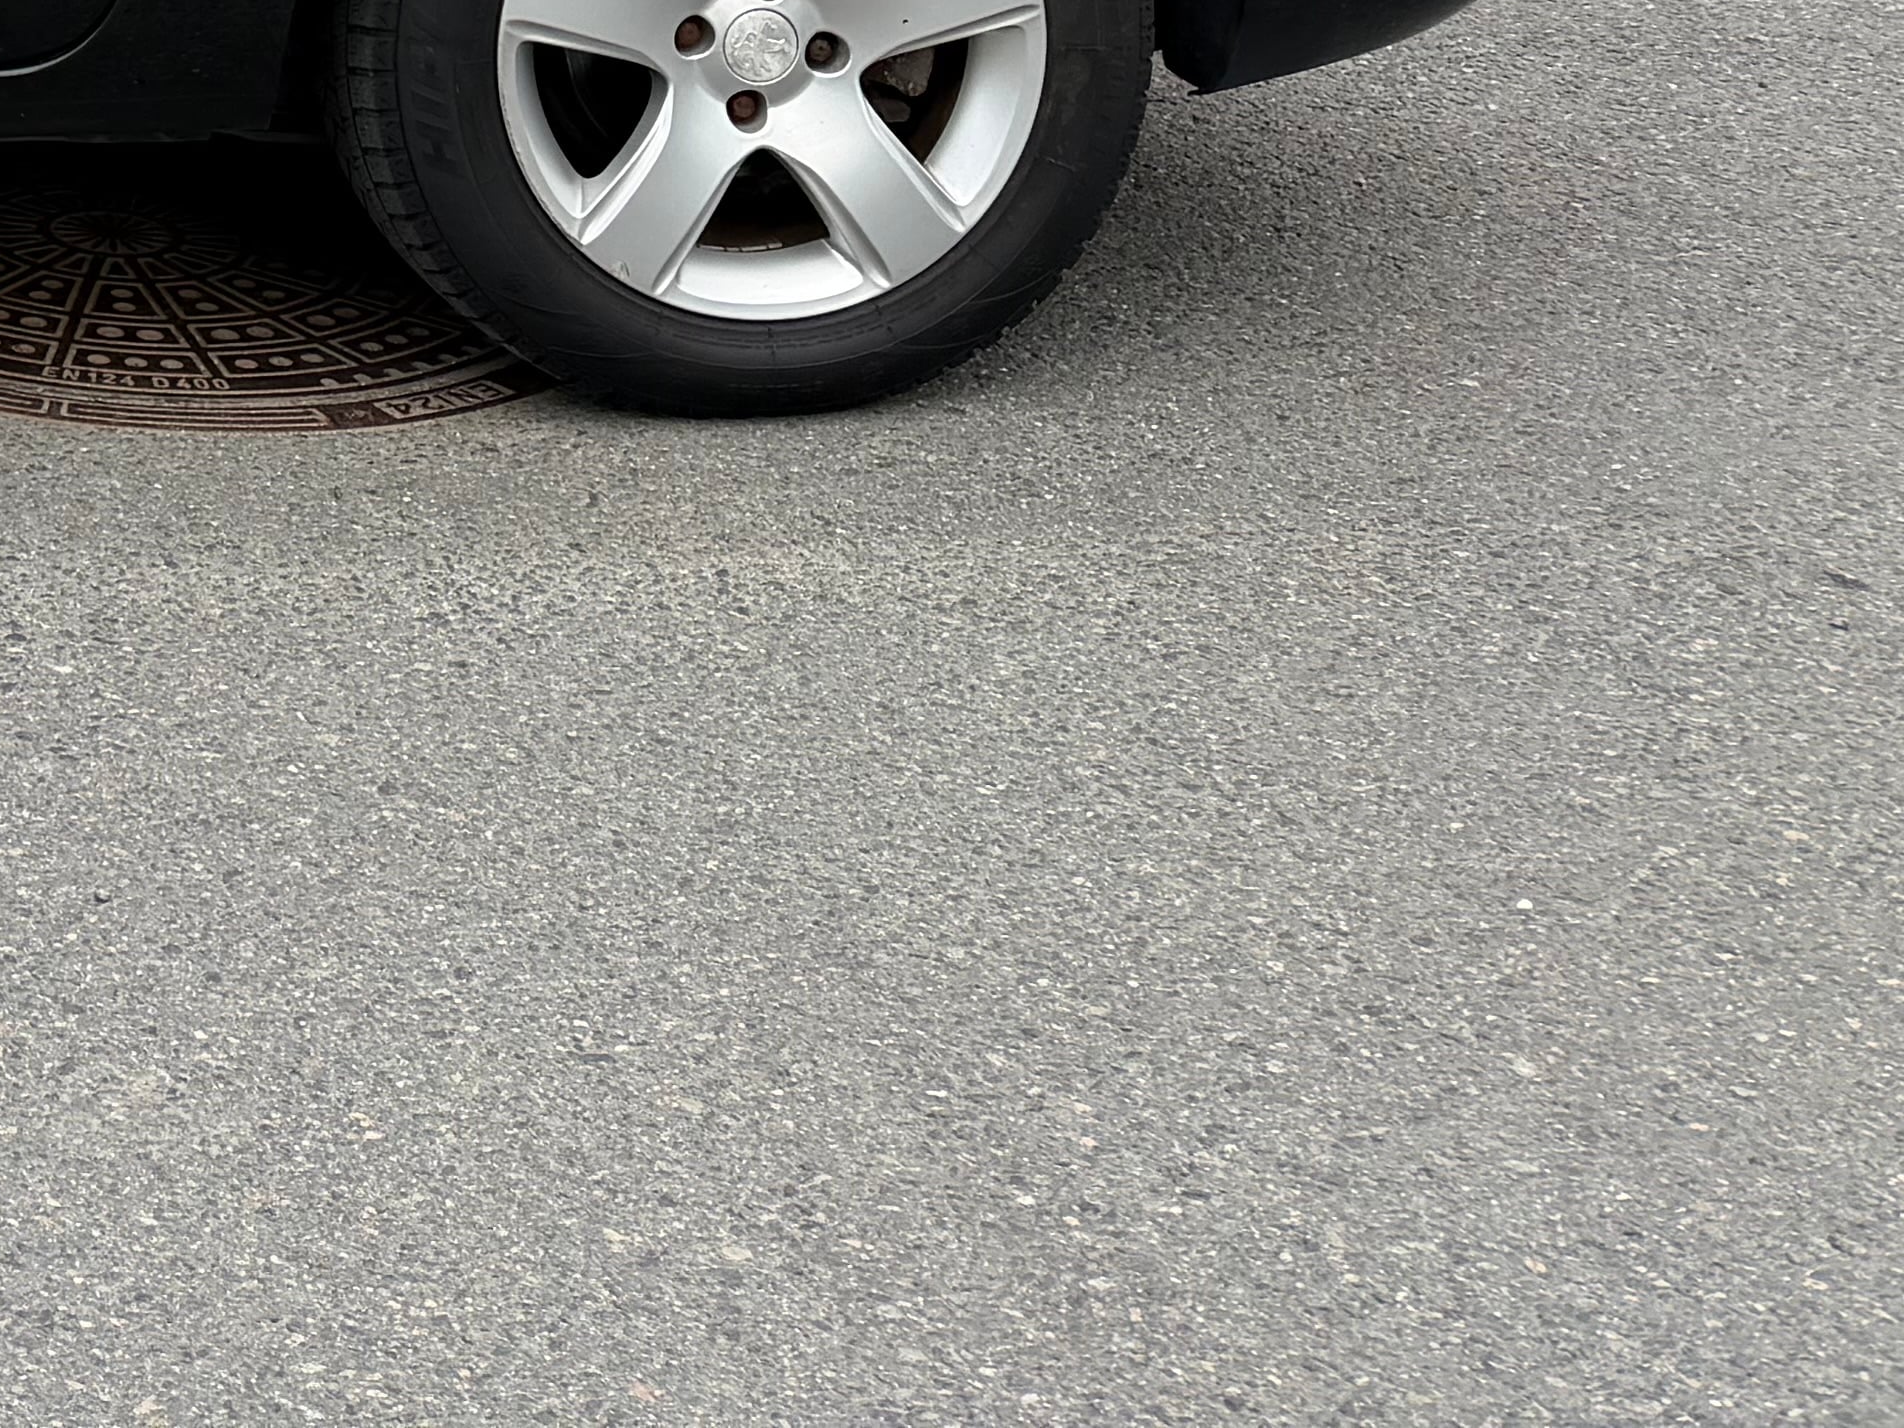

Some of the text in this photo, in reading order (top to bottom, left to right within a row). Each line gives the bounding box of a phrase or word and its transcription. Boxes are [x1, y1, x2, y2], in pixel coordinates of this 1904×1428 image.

[42, 366, 231, 390] EN 124 D 400
